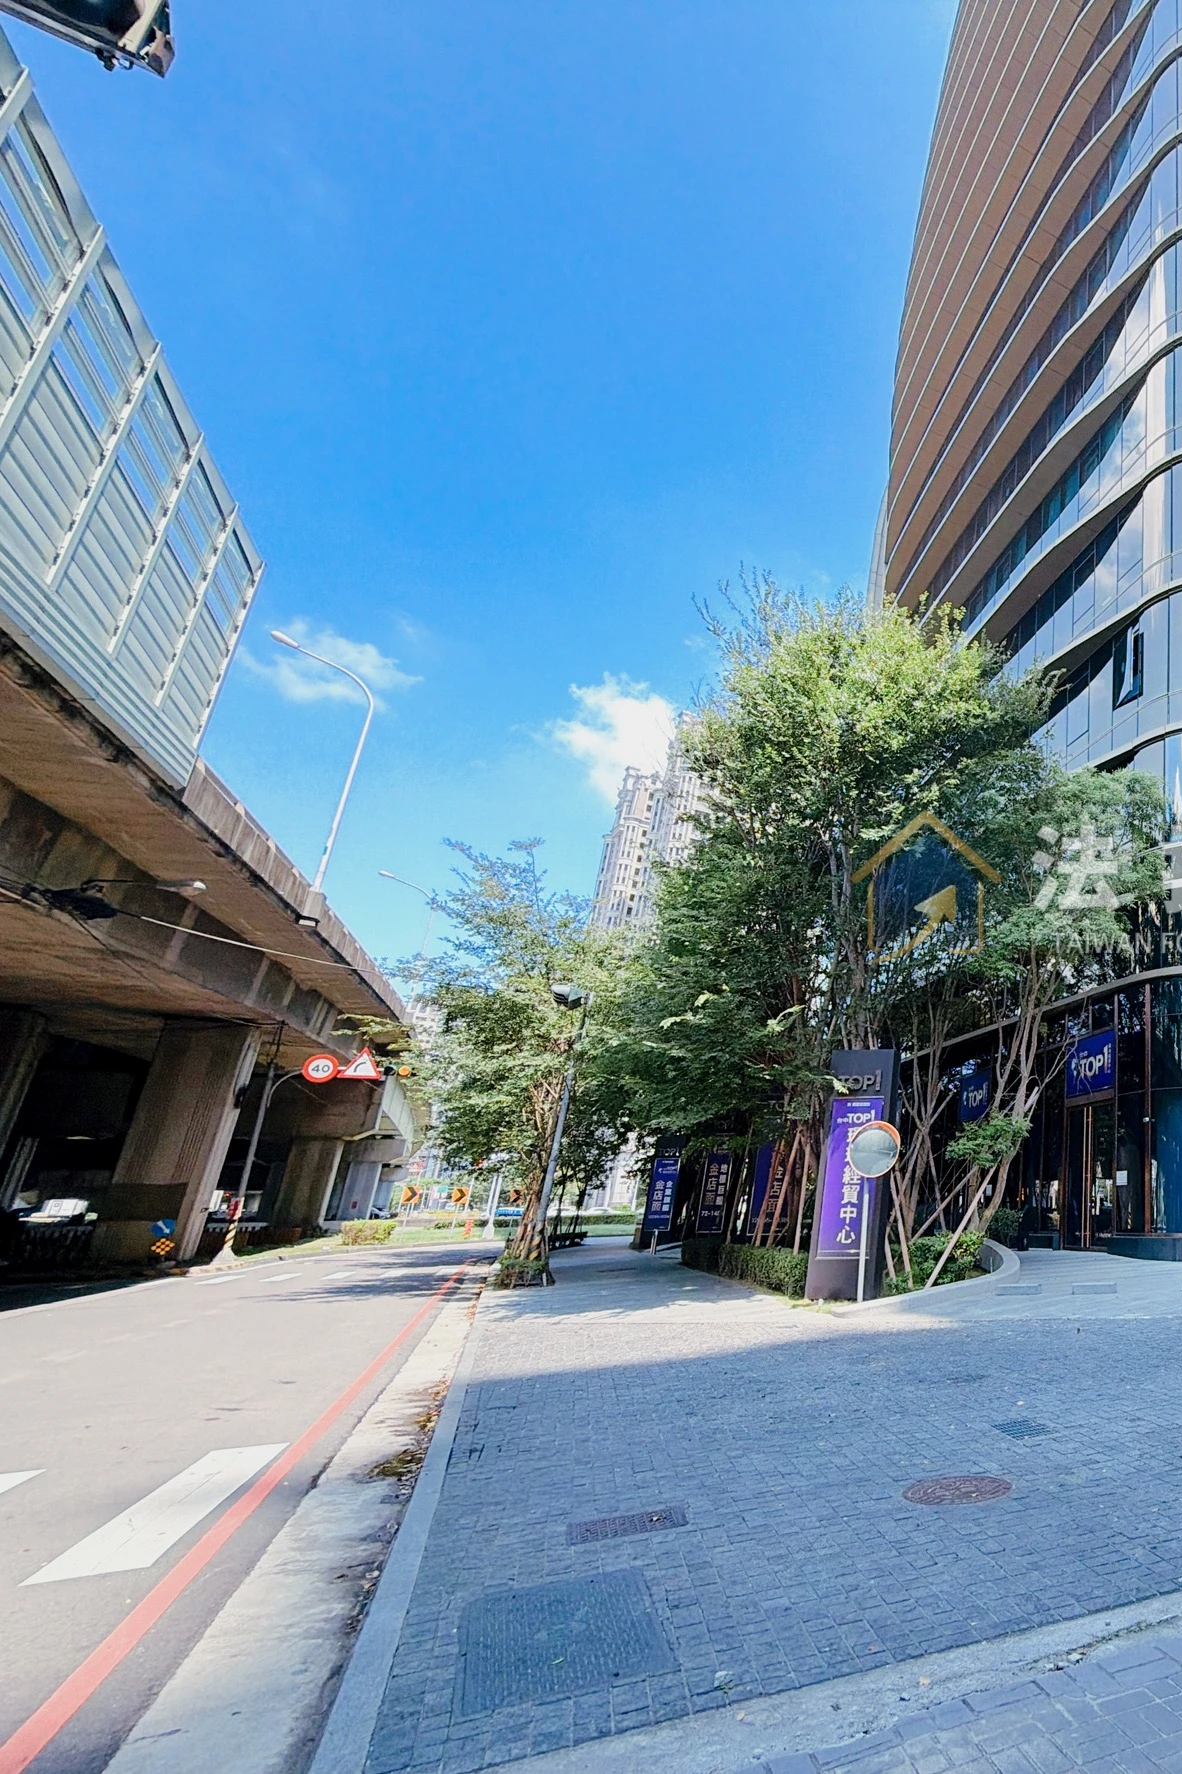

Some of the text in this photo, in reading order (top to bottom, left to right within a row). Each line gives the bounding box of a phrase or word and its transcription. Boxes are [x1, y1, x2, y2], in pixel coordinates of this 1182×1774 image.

[311, 1064, 331, 1074] 40
[836, 1127, 861, 1244] 經貿中心
